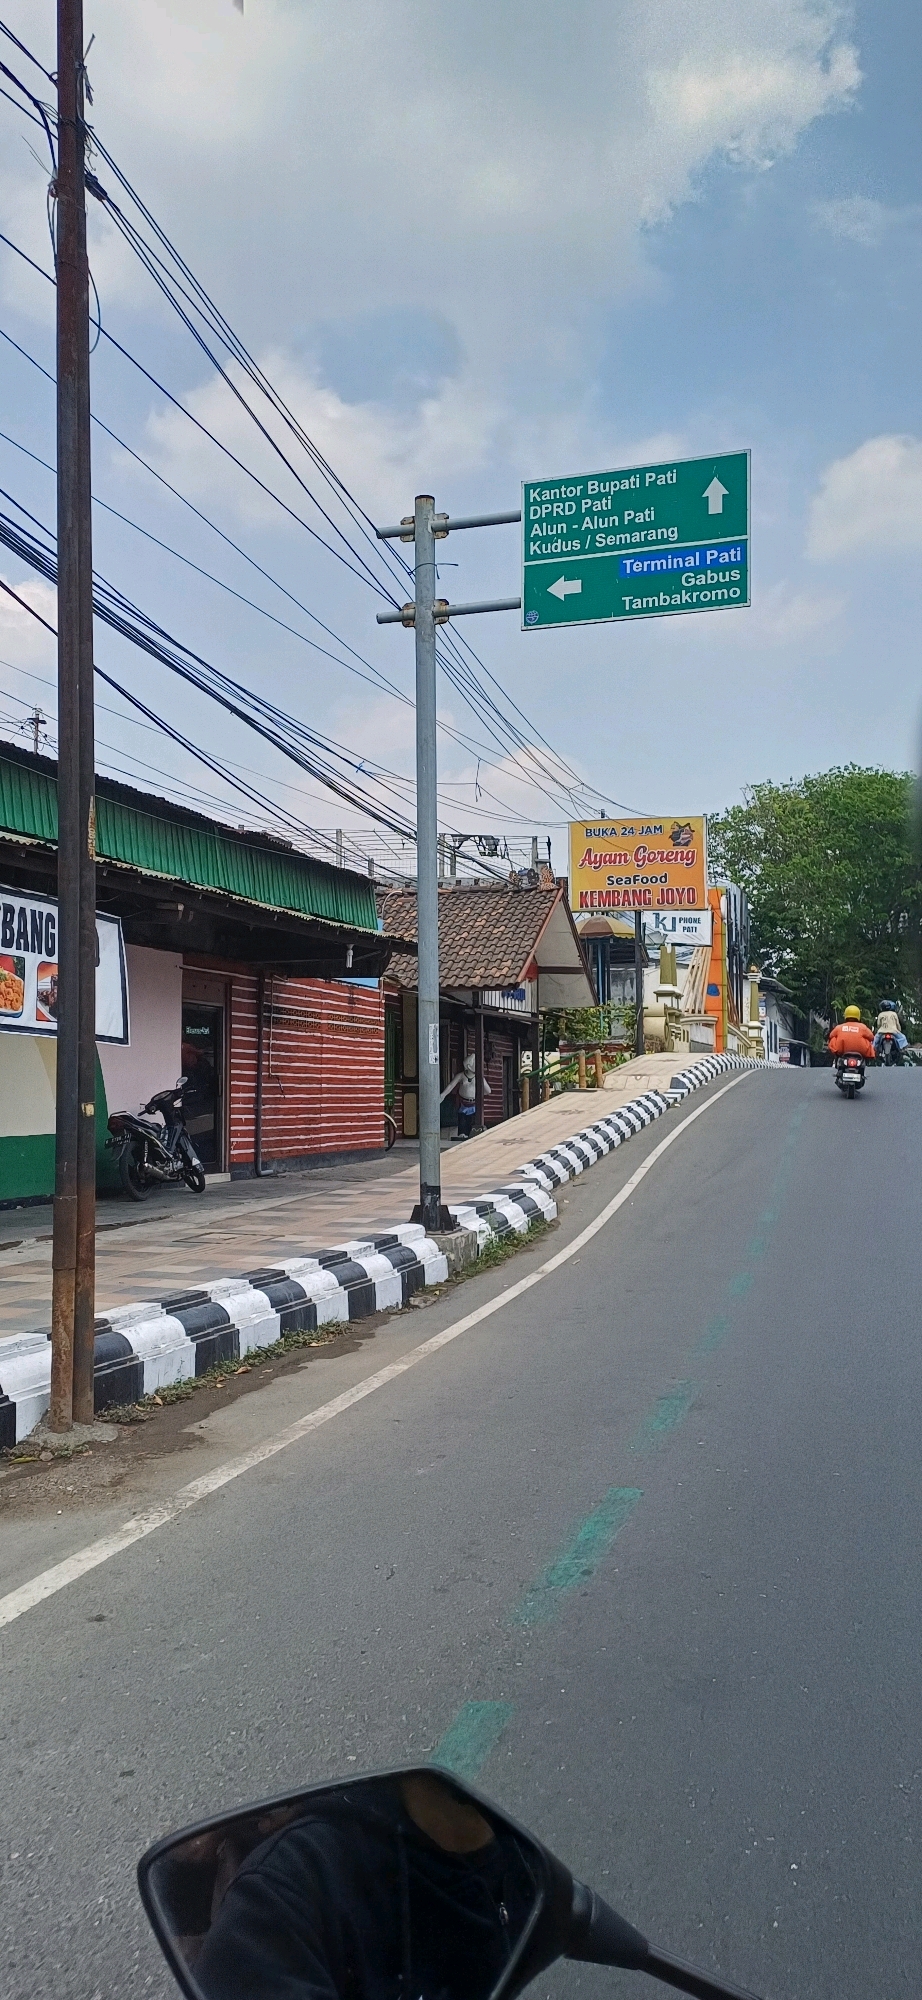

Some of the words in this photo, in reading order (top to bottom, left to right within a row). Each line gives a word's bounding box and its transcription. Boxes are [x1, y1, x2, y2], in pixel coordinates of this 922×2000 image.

[529, 484, 583, 502] Kantor
[587, 474, 640, 495] Bupati
[645, 469, 677, 486] Pati
[530, 502, 576, 519] DPRD
[581, 496, 612, 513] Pati
[530, 520, 567, 538] Alun
[581, 513, 619, 531] Alun
[624, 507, 655, 524] Pati
[530, 537, 581, 555] Kudus
[595, 526, 678, 546] Semarang
[623, 552, 700, 574] Terminal
[706, 547, 742, 565] Pati
[681, 568, 741, 587] Gabus
[622, 586, 741, 611] Tambakromo
[585, 827, 618, 838] BUKA
[620, 826, 635, 836] 24
[638, 824, 663, 835] JAM
[578, 848, 630, 870] Ayam
[633, 845, 697, 868] Goreng
[606, 873, 668, 886] SeaFood
[579, 889, 652, 908] KEMBANG
[656, 887, 697, 906] JOYO
[0, 902, 56, 957] BANG
[678, 917, 702, 925] PHONE
